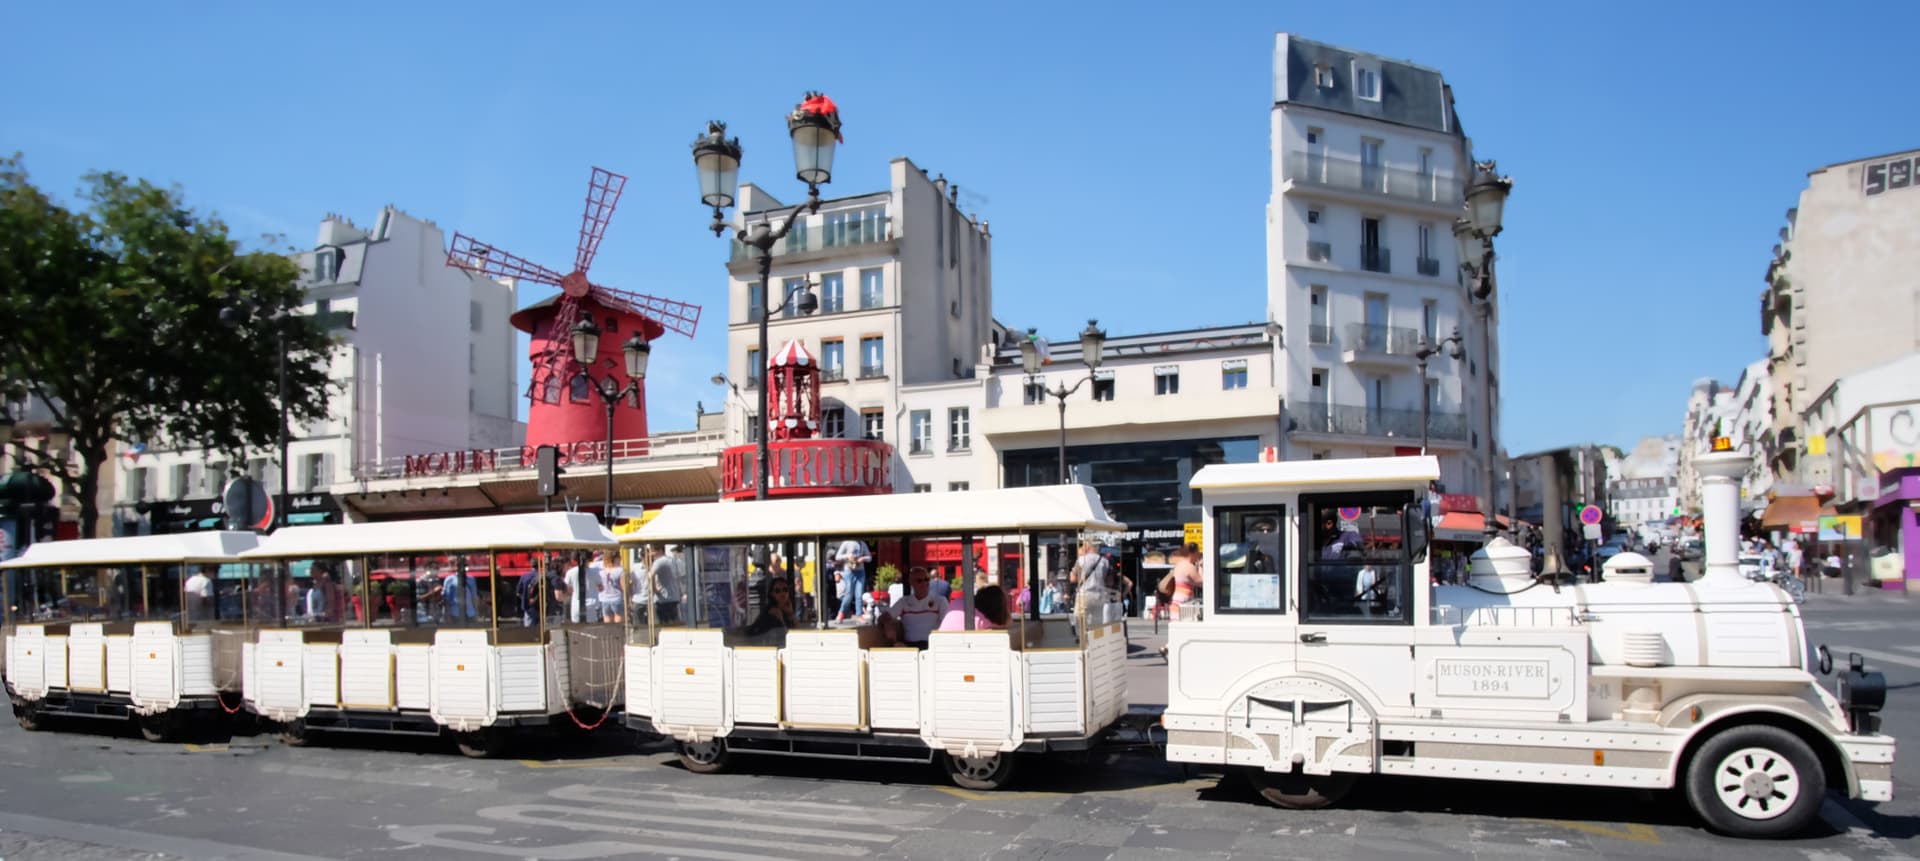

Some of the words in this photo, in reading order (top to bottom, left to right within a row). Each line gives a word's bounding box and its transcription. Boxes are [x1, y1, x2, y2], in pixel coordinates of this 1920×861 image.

[405, 448, 496, 476] MOULIN
[520, 440, 609, 469] RUGE
[789, 446, 893, 491] ROUGE
[1472, 679, 1510, 691] 1894
